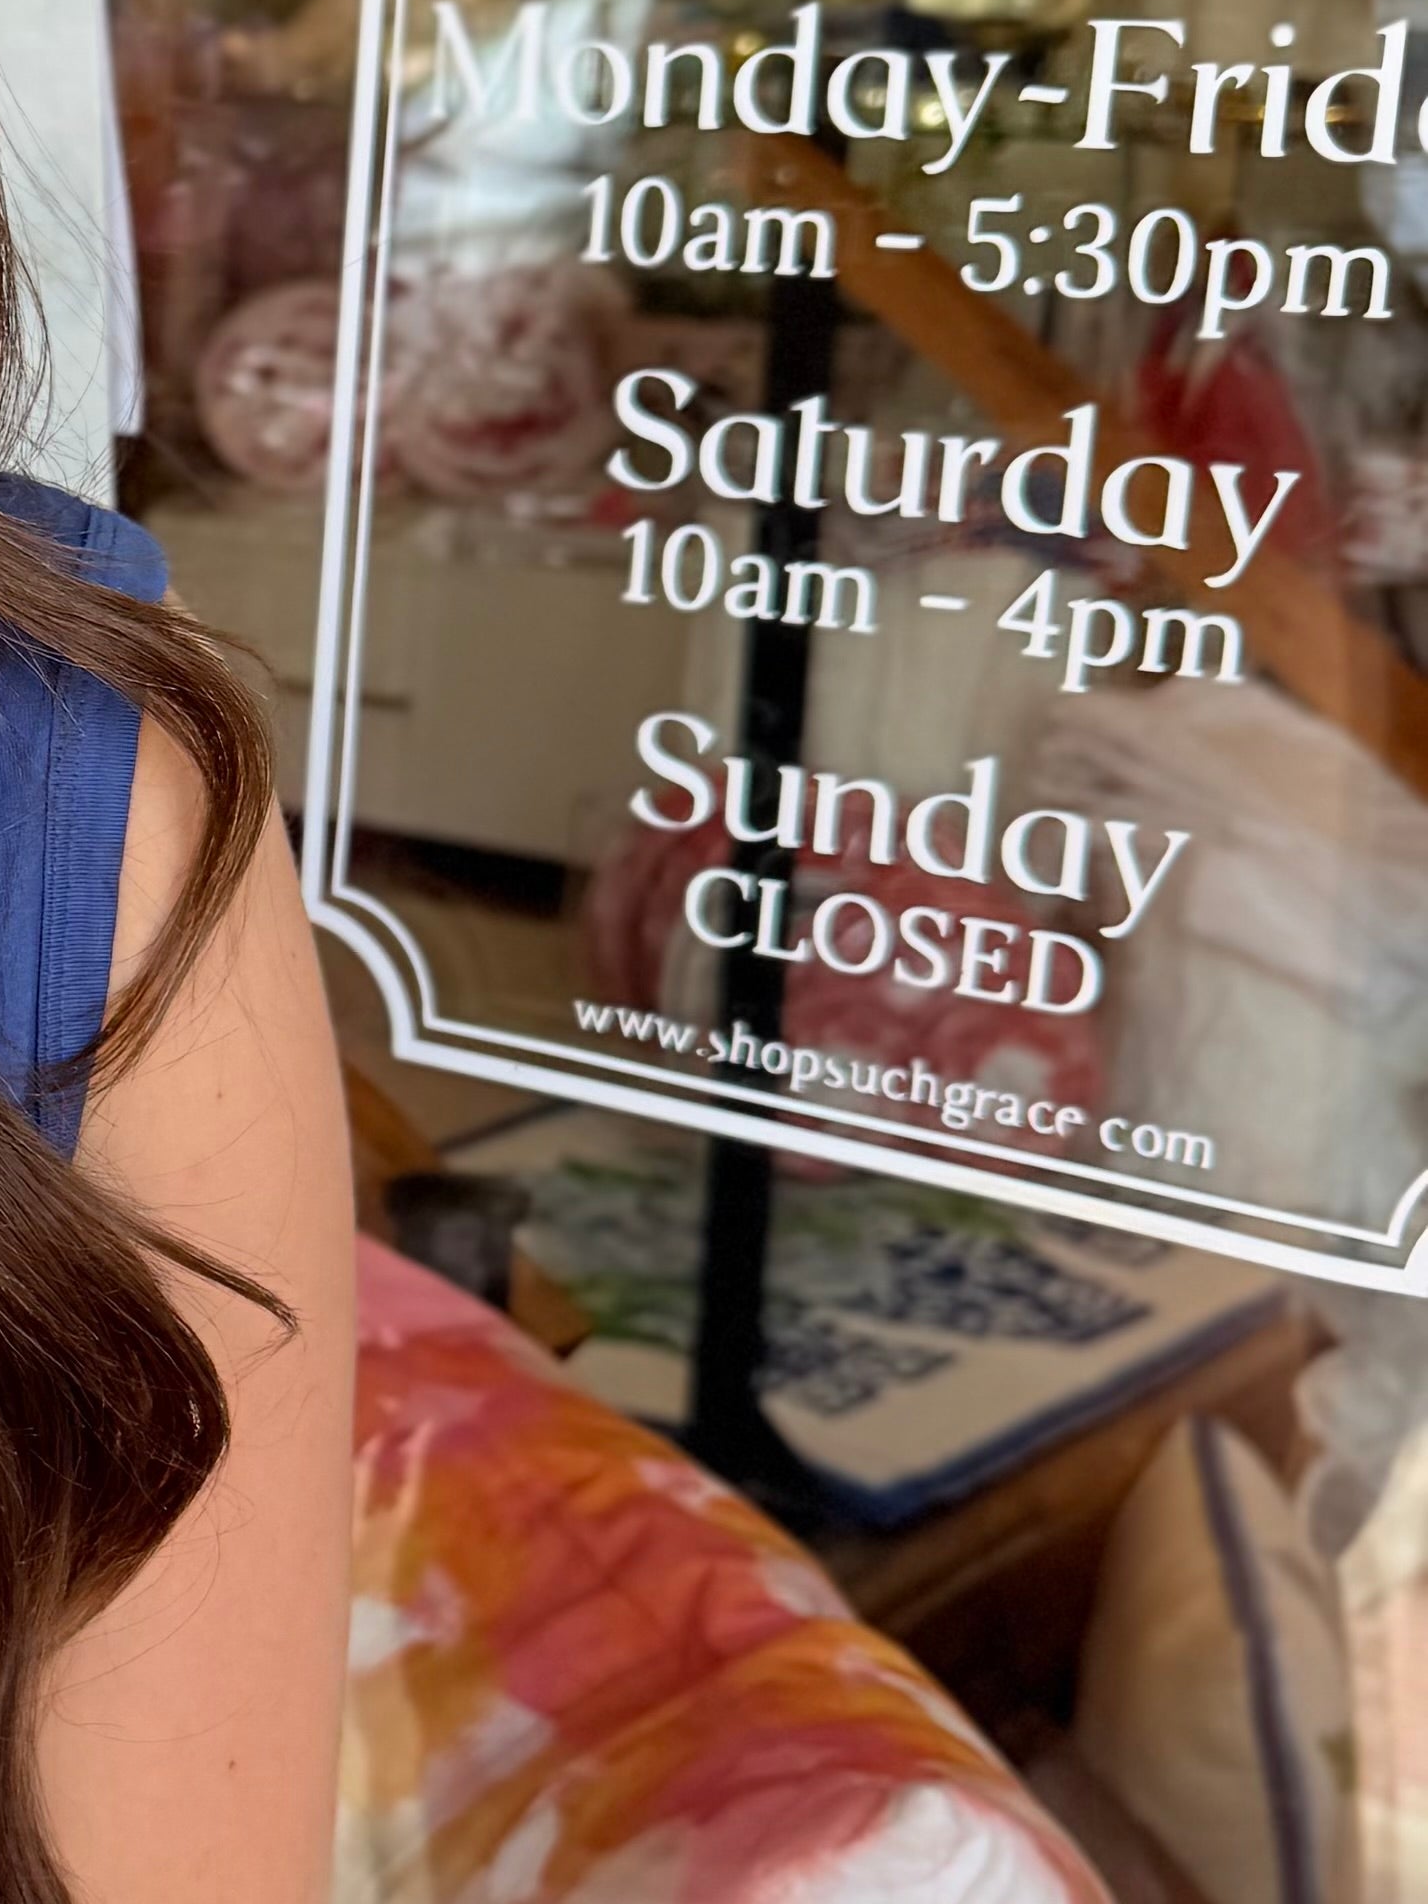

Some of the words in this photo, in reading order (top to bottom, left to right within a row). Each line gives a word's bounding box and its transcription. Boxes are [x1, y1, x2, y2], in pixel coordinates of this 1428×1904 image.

[429, 1, 1428, 176] Monday-Frid
[578, 173, 839, 280] 10am
[874, 230, 927, 254] -
[958, 192, 1392, 340] 5:30pm
[606, 368, 1301, 590] Saturday
[619, 518, 879, 635] 10am
[919, 592, 968, 612] -
[996, 568, 1247, 694] 4pm
[628, 711, 1192, 940] Sunday
[684, 866, 1104, 1016] CLOSED
